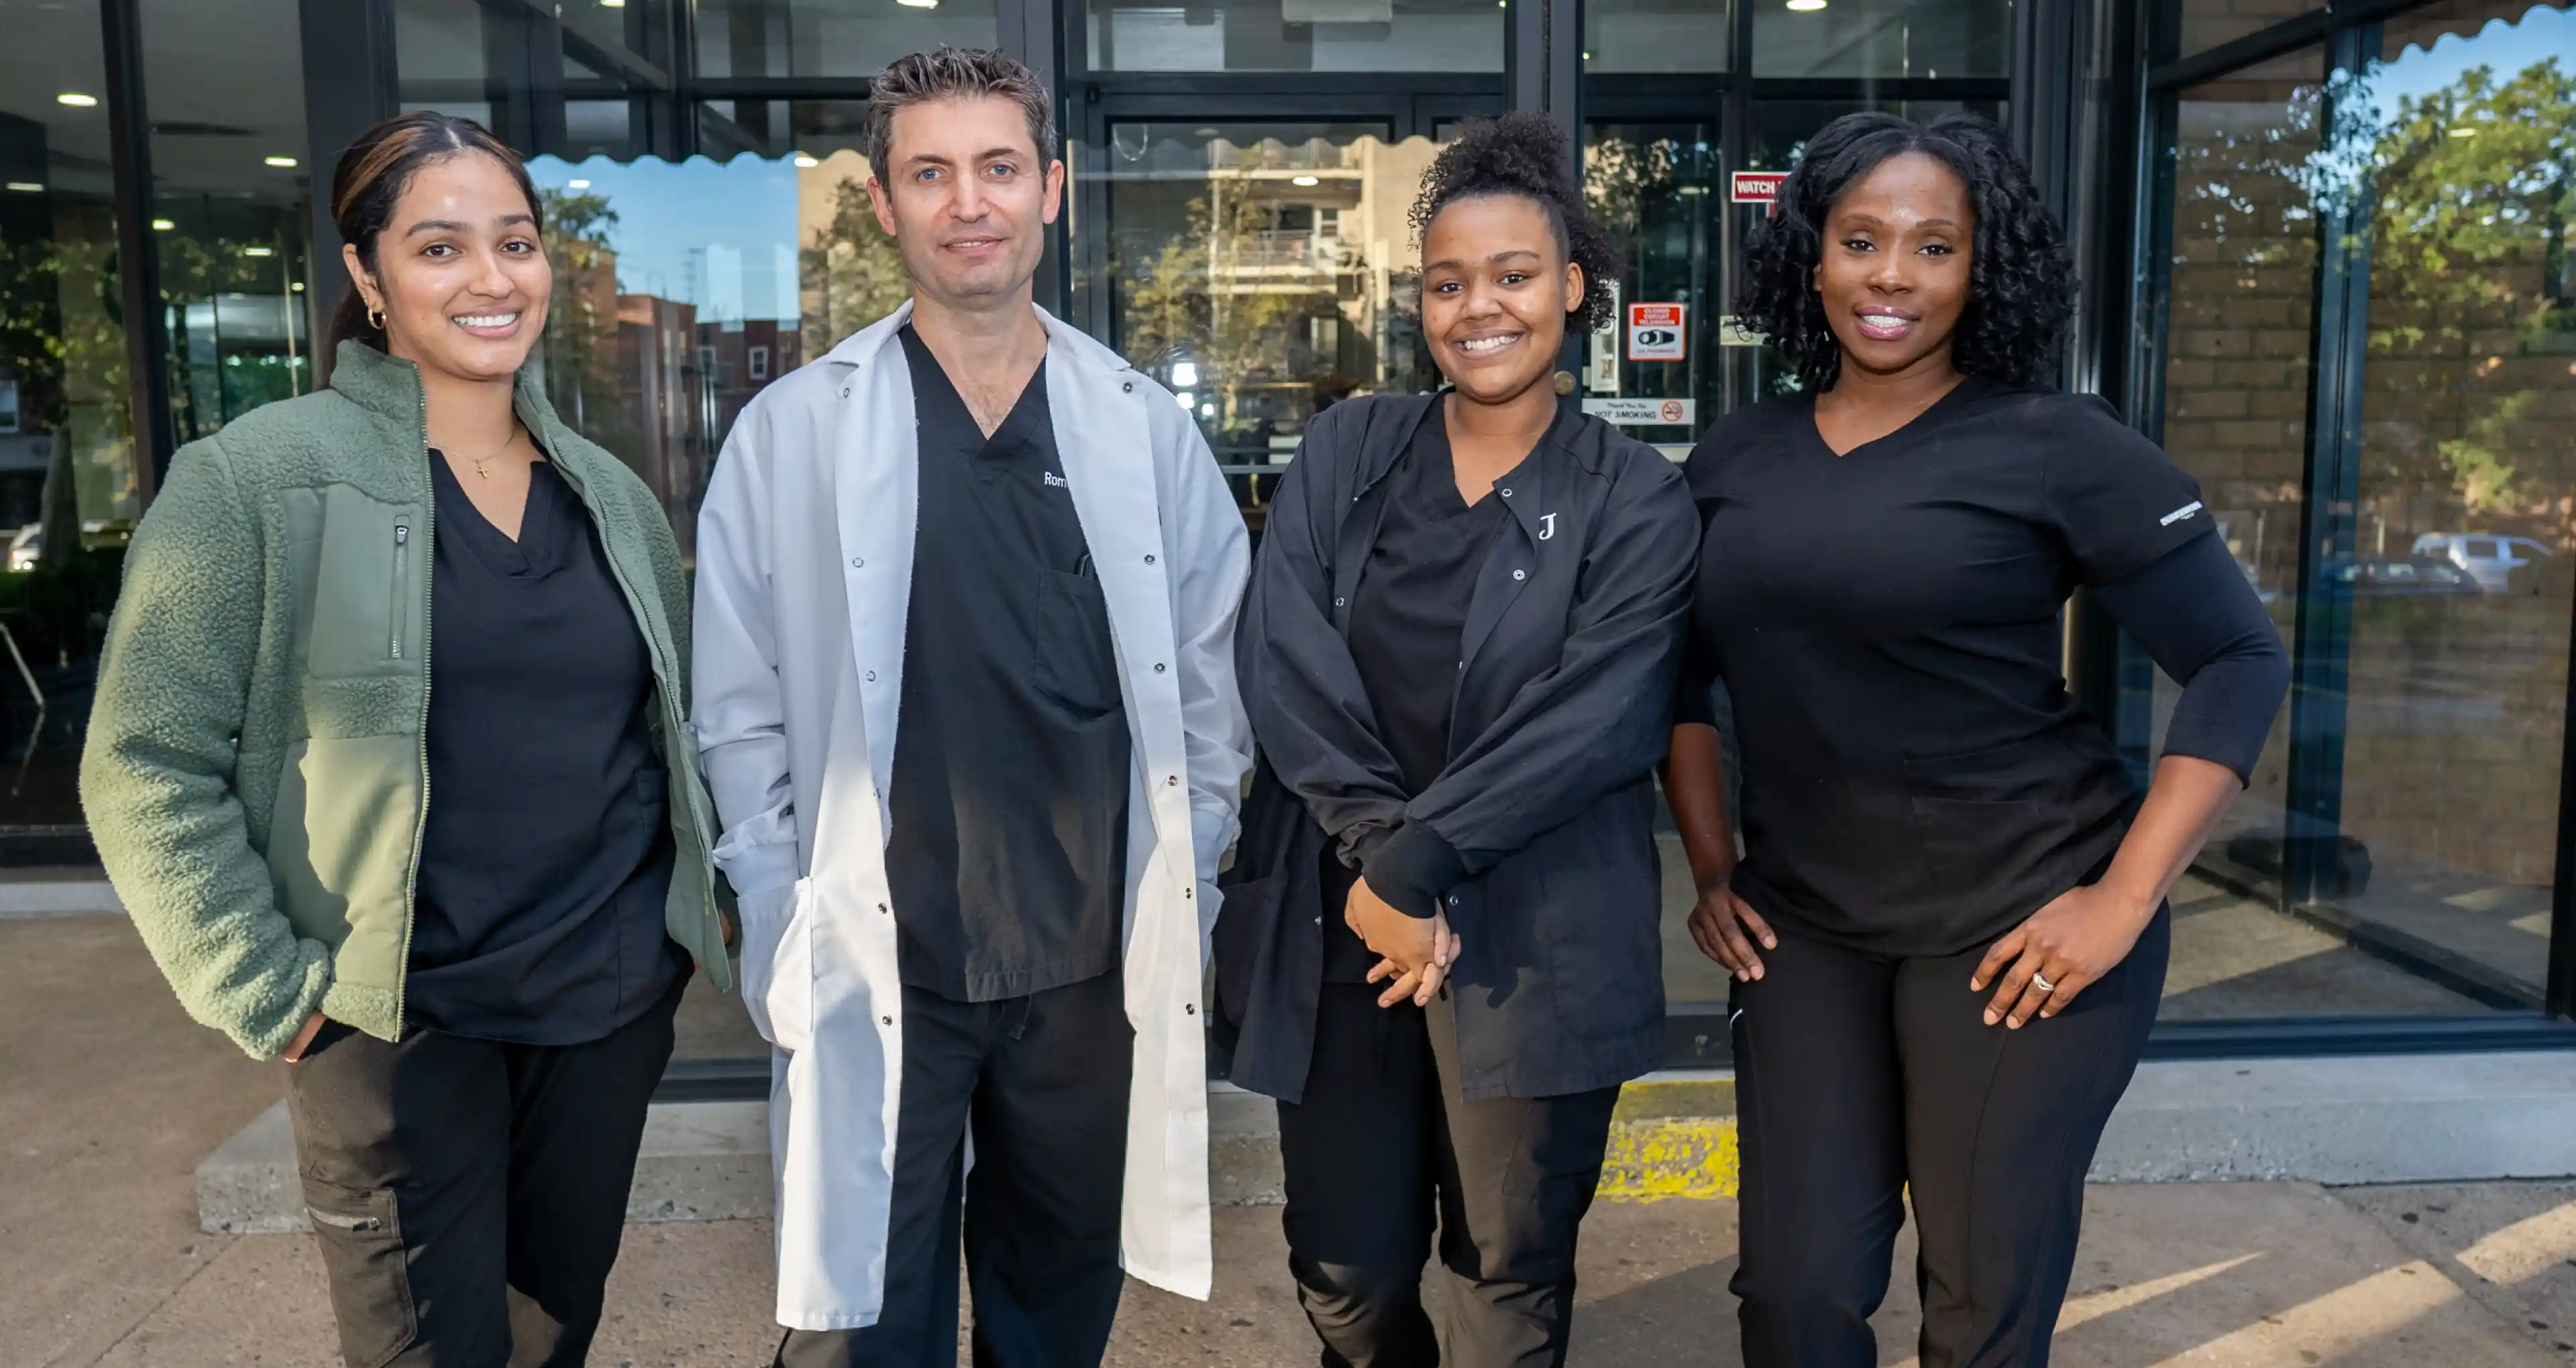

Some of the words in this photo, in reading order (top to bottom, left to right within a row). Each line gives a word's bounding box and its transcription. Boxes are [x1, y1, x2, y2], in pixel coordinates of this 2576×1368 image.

[1737, 180, 1775, 194] WATCH
[1615, 411, 1656, 419] SMOKING
[1539, 512, 1557, 540] J
